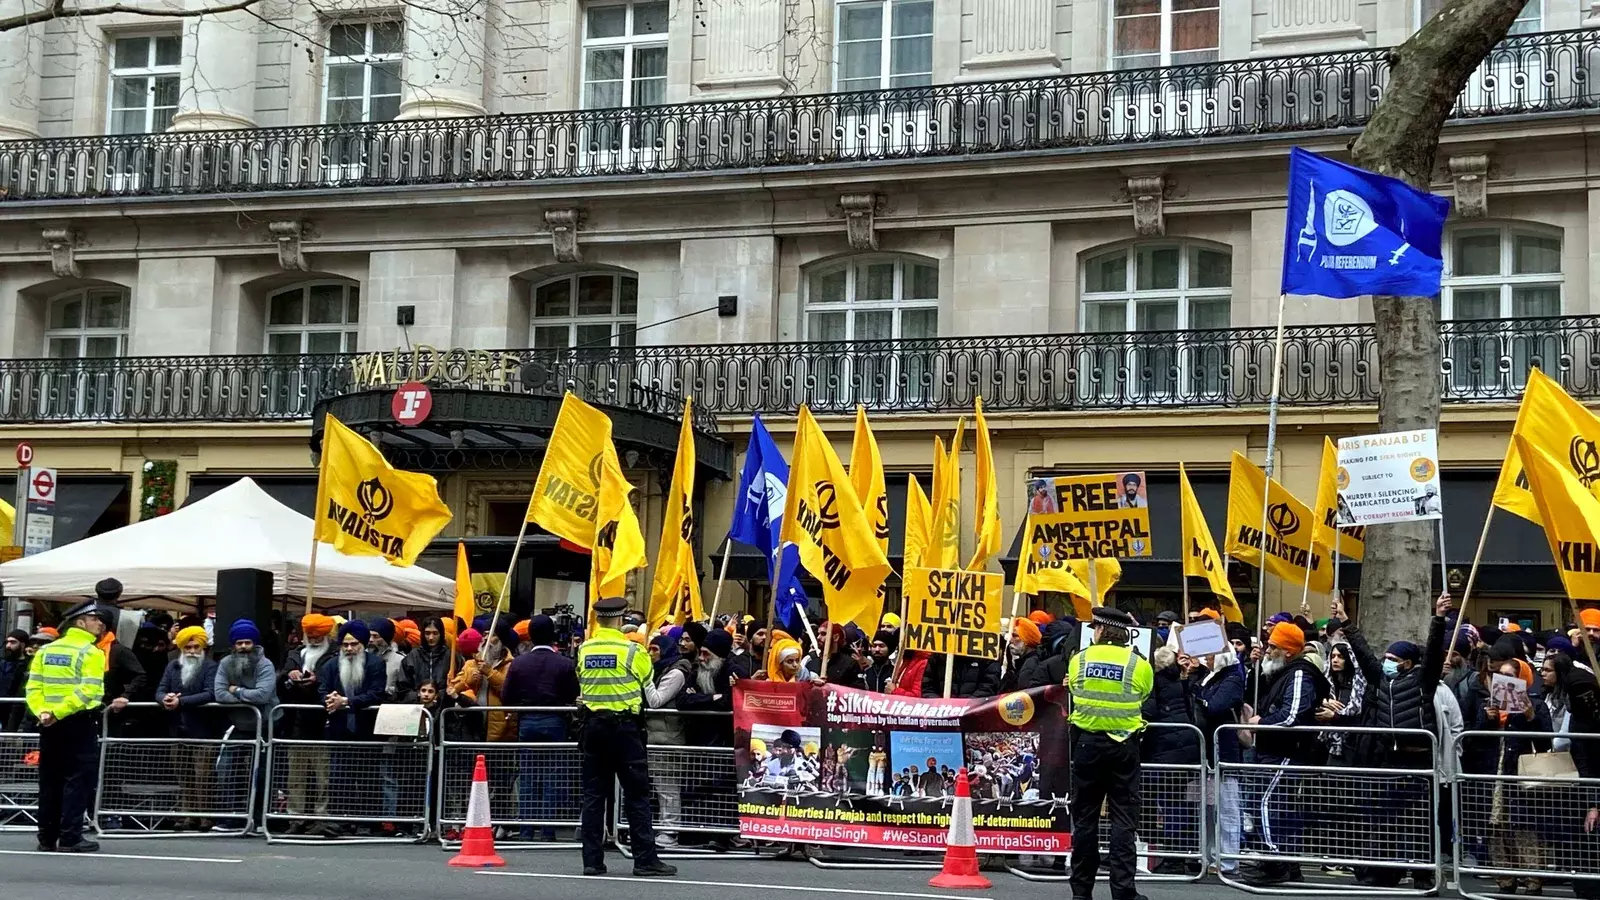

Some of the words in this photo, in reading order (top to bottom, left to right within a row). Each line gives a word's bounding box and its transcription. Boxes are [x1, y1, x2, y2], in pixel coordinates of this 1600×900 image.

[1335, 255, 1377, 270] REFERENDUM
[351, 343, 521, 387] WALDORF
[1364, 435, 1409, 448] PANJAB
[1412, 433, 1428, 442] DE
[21, 445, 32, 462] D
[1361, 473, 1384, 481] SUBJECT
[1055, 482, 1119, 512] FREE
[1346, 492, 1372, 500] MURDER
[1350, 498, 1391, 508] FABRICATED
[1363, 512, 1390, 520] CORRUPT
[1391, 510, 1414, 518] REGIME
[1032, 518, 1149, 544] AMRITPAL
[1054, 538, 1130, 560] SINGH
[1238, 525, 1321, 571] KHALISTAN
[927, 569, 986, 601] SIKH
[920, 598, 986, 629] LIVES
[905, 623, 998, 658] MATTER
[585, 660, 616, 668] POLICE
[1087, 668, 1122, 680] POLICE
[827, 713, 842, 724] Stop
[842, 713, 861, 725] killing
[862, 714, 878, 724] sikhs
[878, 715, 886, 726] by
[886, 716, 898, 725] the
[898, 716, 919, 726] Indian
[919, 717, 961, 728] government
[765, 803, 785, 817] civil
[786, 805, 824, 819] liberties
[824, 807, 834, 819] in
[835, 809, 866, 824] Panjab
[866, 811, 882, 823] and
[883, 812, 917, 826] respect
[917, 812, 933, 824] the
[933, 813, 951, 828] righ
[973, 814, 1057, 829] elf-determination”
